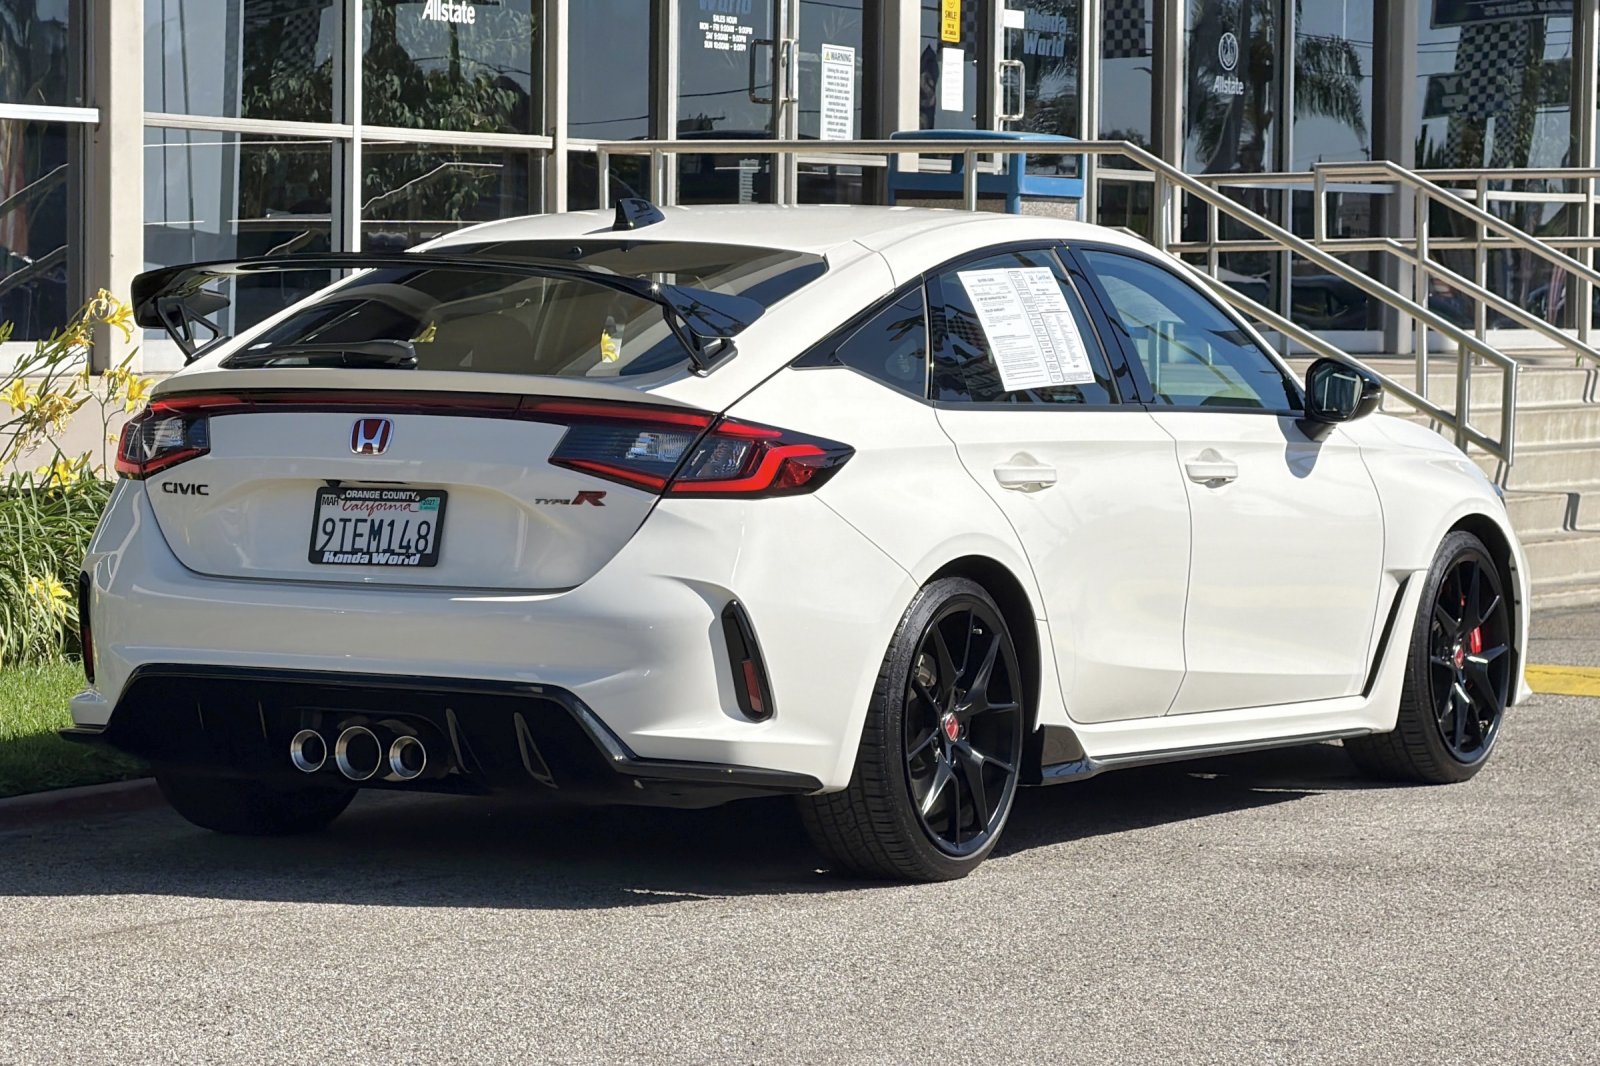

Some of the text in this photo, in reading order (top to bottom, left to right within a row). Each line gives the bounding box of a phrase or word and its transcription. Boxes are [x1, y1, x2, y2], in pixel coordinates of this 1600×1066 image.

[422, 0, 476, 24] Allstate
[1024, 31, 1066, 57] World
[831, 51, 852, 63] WARNING
[1212, 75, 1244, 95] Allstate
[161, 481, 210, 496] CIVIC
[346, 490, 416, 500] ORANGE COUNTY
[321, 494, 339, 506] MAR
[571, 490, 607, 507] R
[342, 499, 419, 517] California
[320, 517, 431, 553] 9TEM148
[322, 551, 370, 564] Honda
